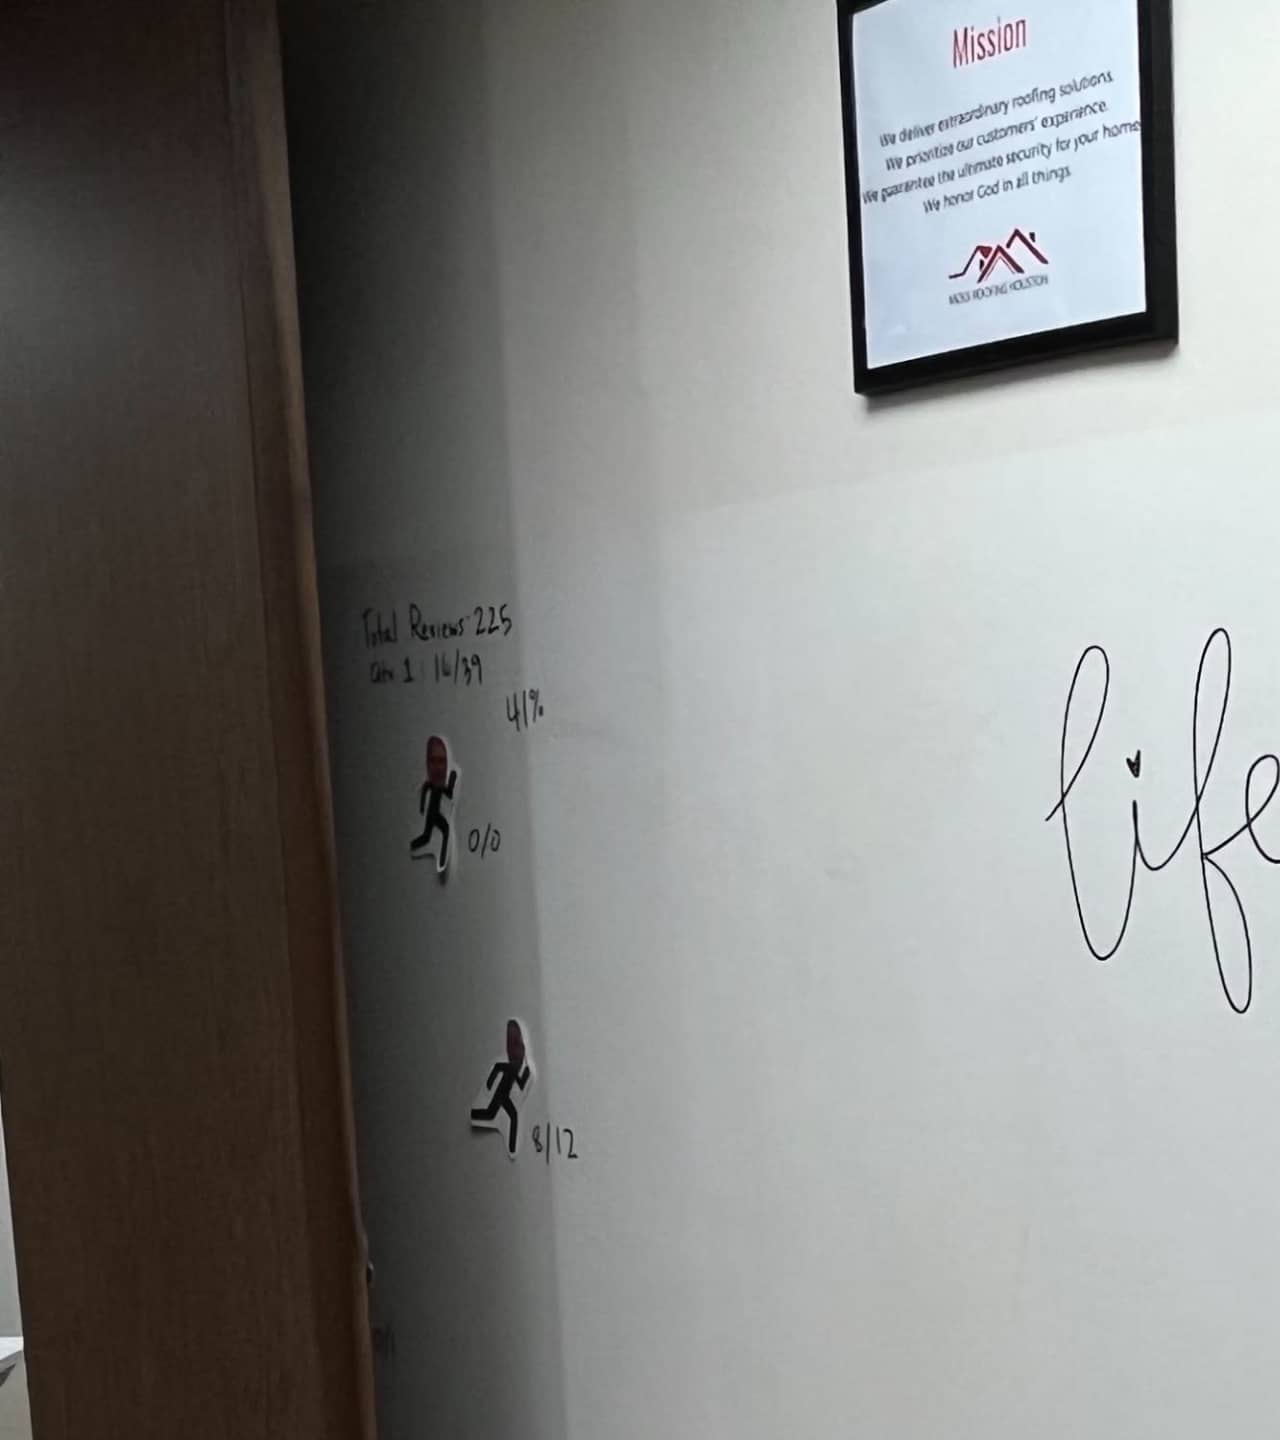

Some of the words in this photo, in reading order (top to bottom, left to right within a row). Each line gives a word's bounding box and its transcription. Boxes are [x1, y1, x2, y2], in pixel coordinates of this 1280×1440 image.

[953, 16, 1026, 69] Mission
[899, 123, 936, 143] deliver
[938, 99, 1009, 132] extraordinary
[1012, 87, 1056, 109] roofing
[885, 156, 904, 171] We
[956, 136, 974, 152] our
[938, 169, 955, 184] the
[957, 155, 1004, 178] ultimate
[1006, 142, 1052, 165] security
[1056, 137, 1071, 152] for
[1073, 129, 1099, 152] your
[923, 199, 941, 213] We
[943, 189, 974, 208] honor
[976, 179, 1000, 198] God
[1002, 178, 1014, 193] in
[1016, 170, 1029, 190] all
[362, 607, 398, 649] Total
[474, 603, 513, 637] 225
[468, 823, 501, 860] 0/0
[532, 1122, 579, 1166] 8/12
